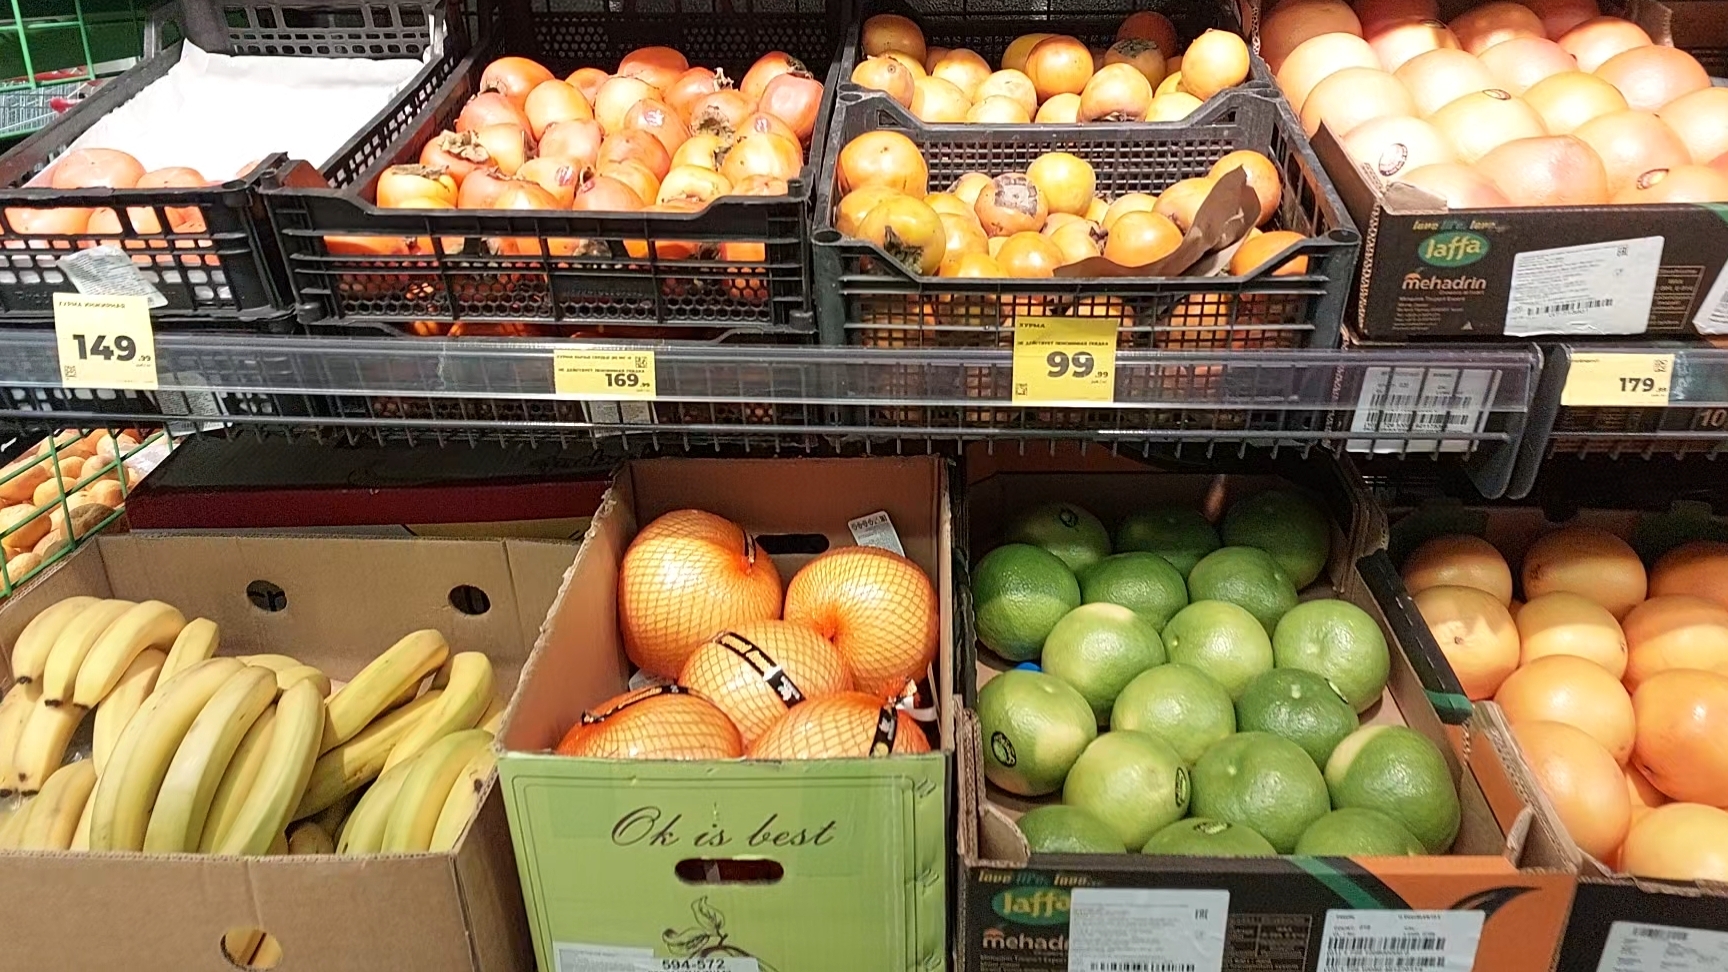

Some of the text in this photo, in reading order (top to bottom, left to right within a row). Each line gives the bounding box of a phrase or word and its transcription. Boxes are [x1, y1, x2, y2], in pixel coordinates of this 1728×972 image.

[1425, 236, 1481, 260] laffa
[1402, 273, 1487, 291] mehadrin
[72, 334, 137, 361] 149
[1046, 351, 1095, 378] 99
[605, 373, 639, 387] 169
[1619, 377, 1655, 392] 179
[1700, 409, 1727, 427] 10
[611, 806, 838, 848] Ok is best
[662, 958, 726, 971] 594-572
